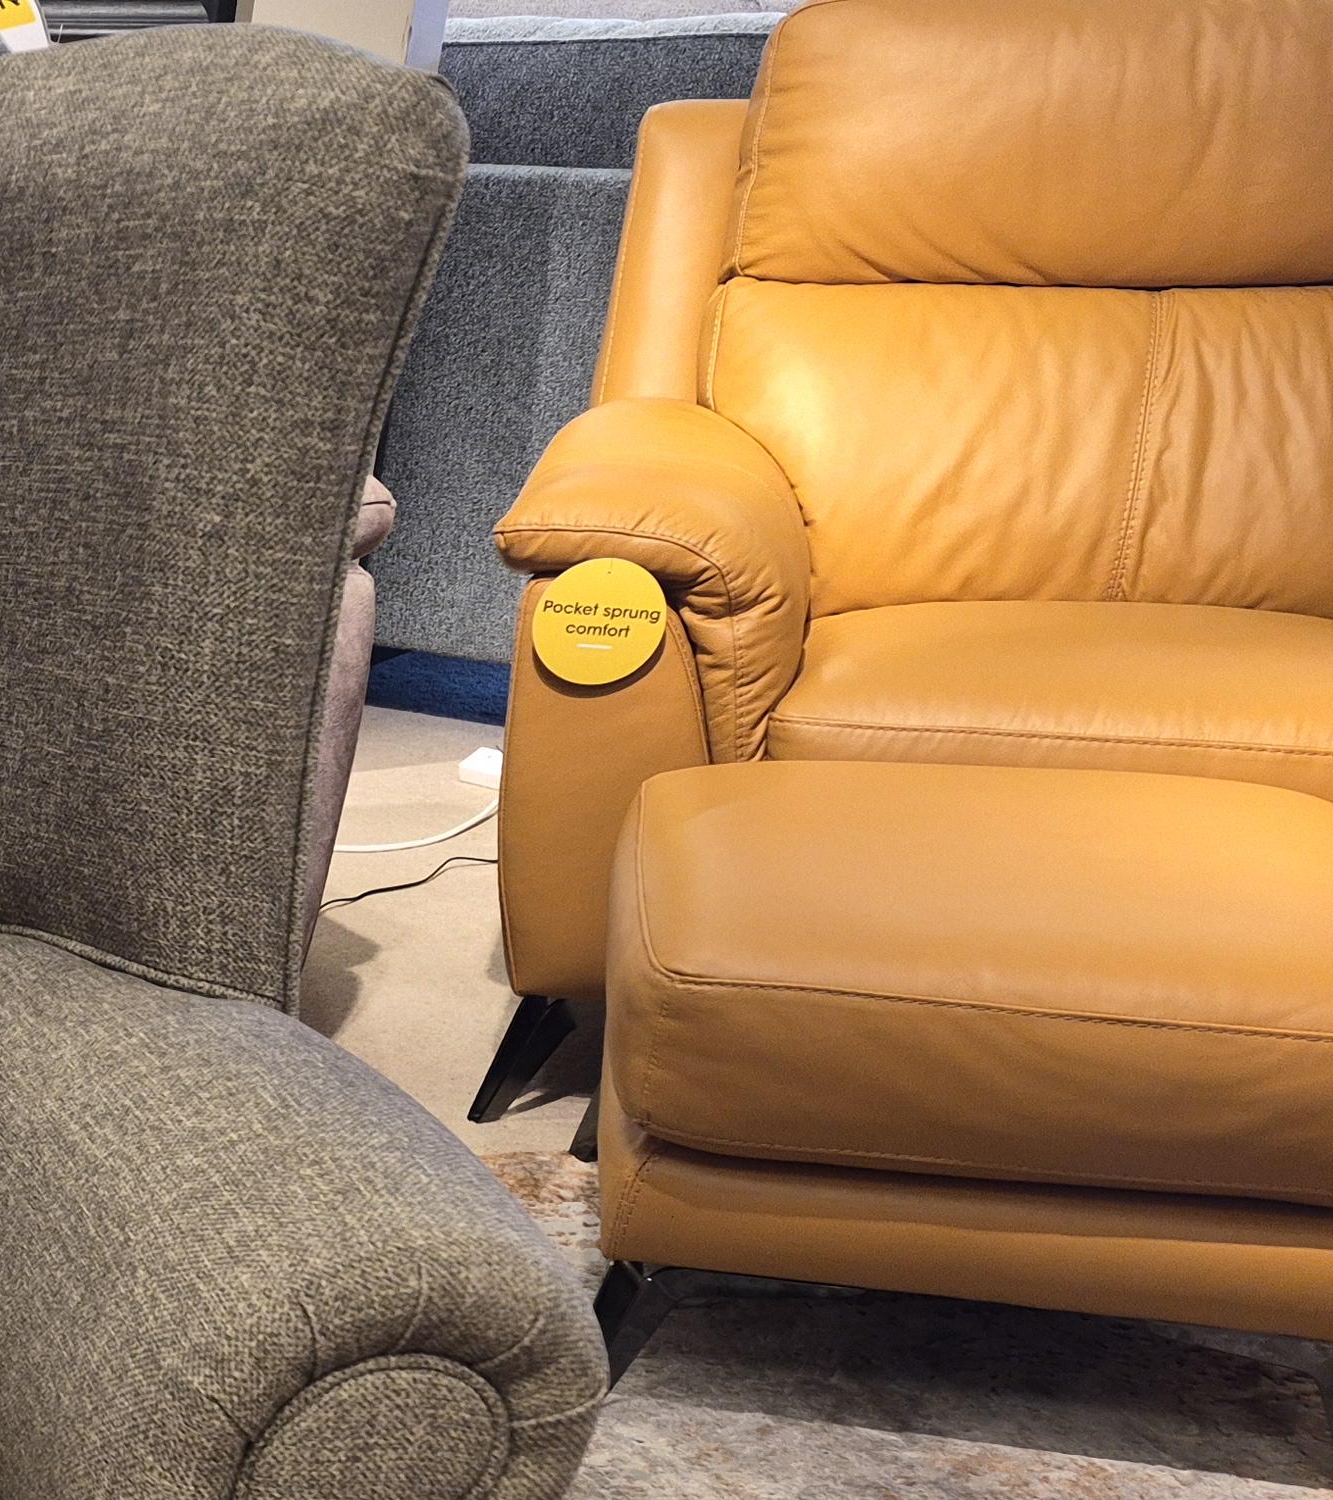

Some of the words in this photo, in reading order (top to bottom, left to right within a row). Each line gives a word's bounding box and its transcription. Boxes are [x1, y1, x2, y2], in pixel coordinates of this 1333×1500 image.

[543, 600, 598, 616] Pocket
[603, 604, 661, 624] sprung
[565, 623, 630, 638] comfort
